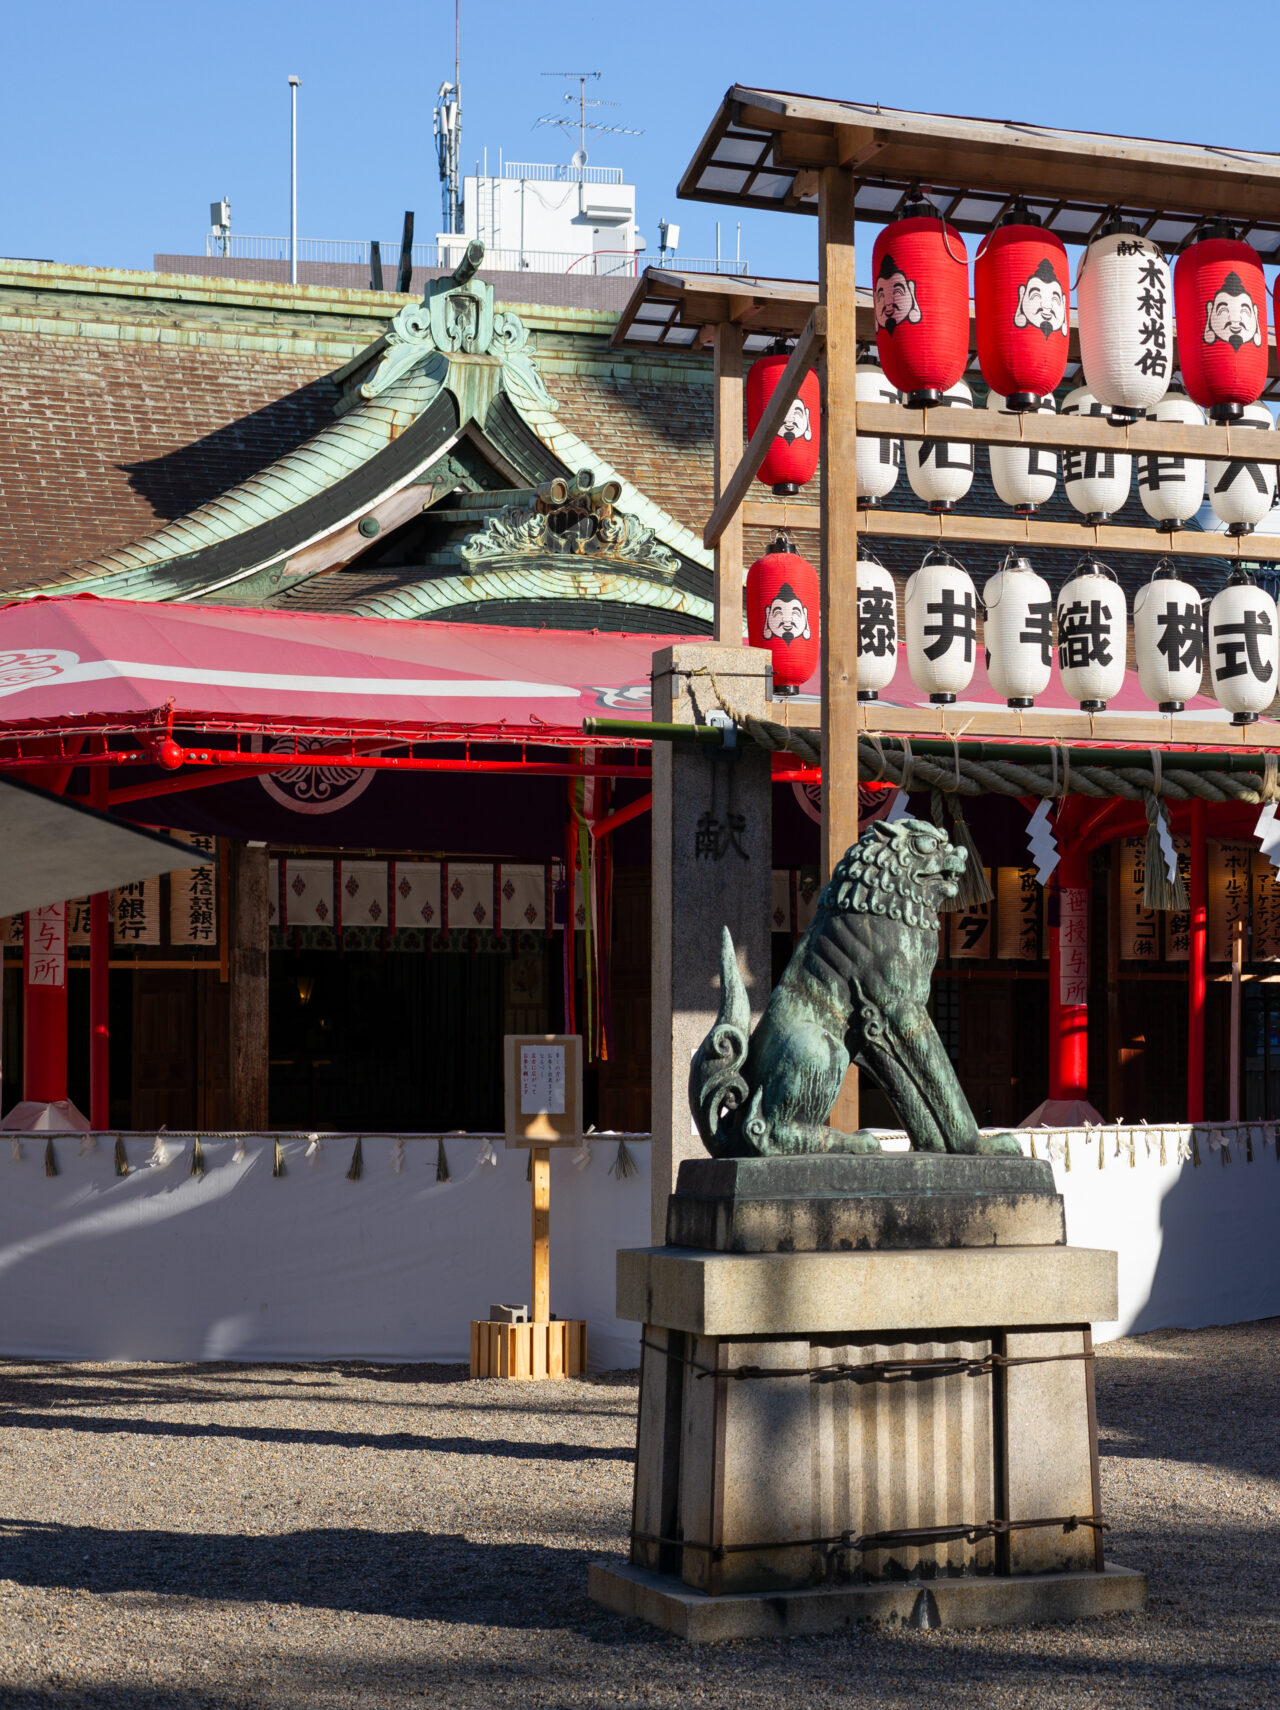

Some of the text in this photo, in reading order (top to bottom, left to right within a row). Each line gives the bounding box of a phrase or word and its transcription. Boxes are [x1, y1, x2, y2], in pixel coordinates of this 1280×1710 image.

[1134, 259, 1168, 379] 木村光佑
[1065, 889, 1088, 1002] 笹授与所
